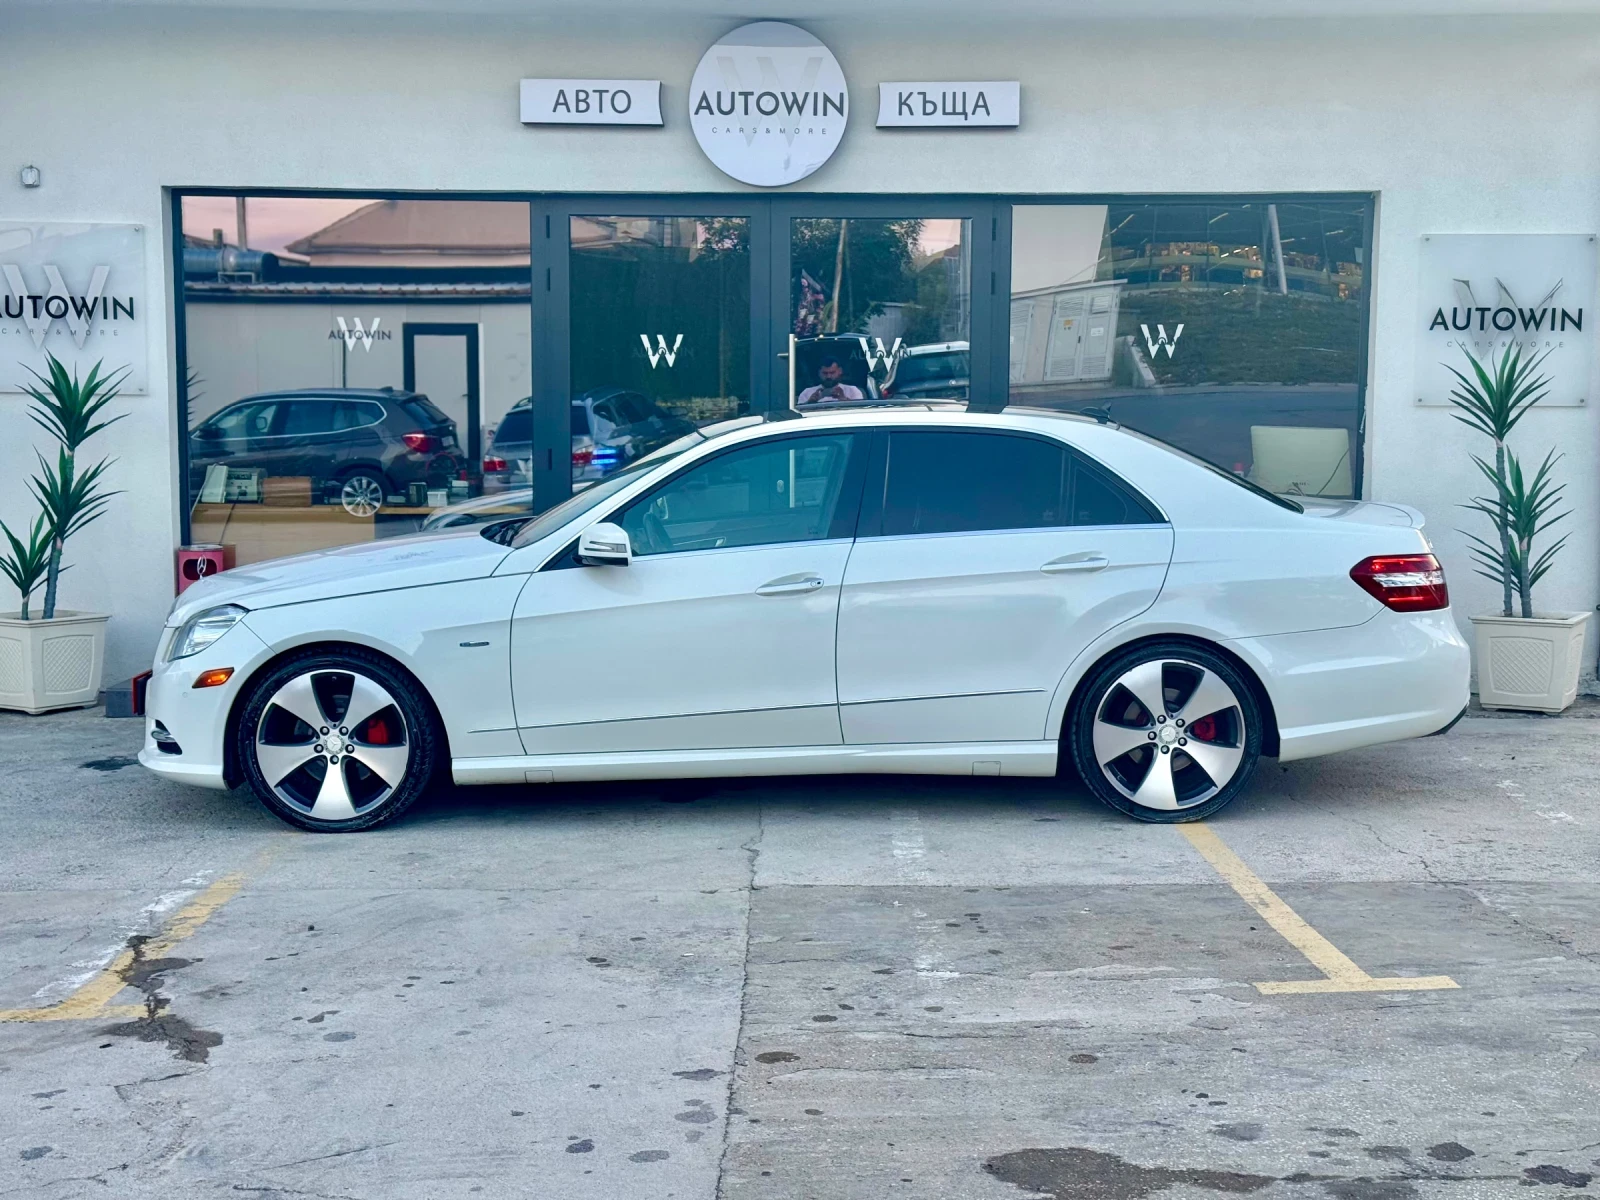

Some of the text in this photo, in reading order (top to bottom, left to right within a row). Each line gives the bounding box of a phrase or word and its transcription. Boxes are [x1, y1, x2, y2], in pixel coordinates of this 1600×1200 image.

[551, 88, 632, 114] АВТО
[693, 90, 845, 118] AUTOWIN
[898, 91, 991, 121] КЪЩА
[0, 294, 135, 321] UTOWIN
[1428, 306, 1584, 333] AUTOWIN
[327, 329, 392, 341] AUTOWIN
